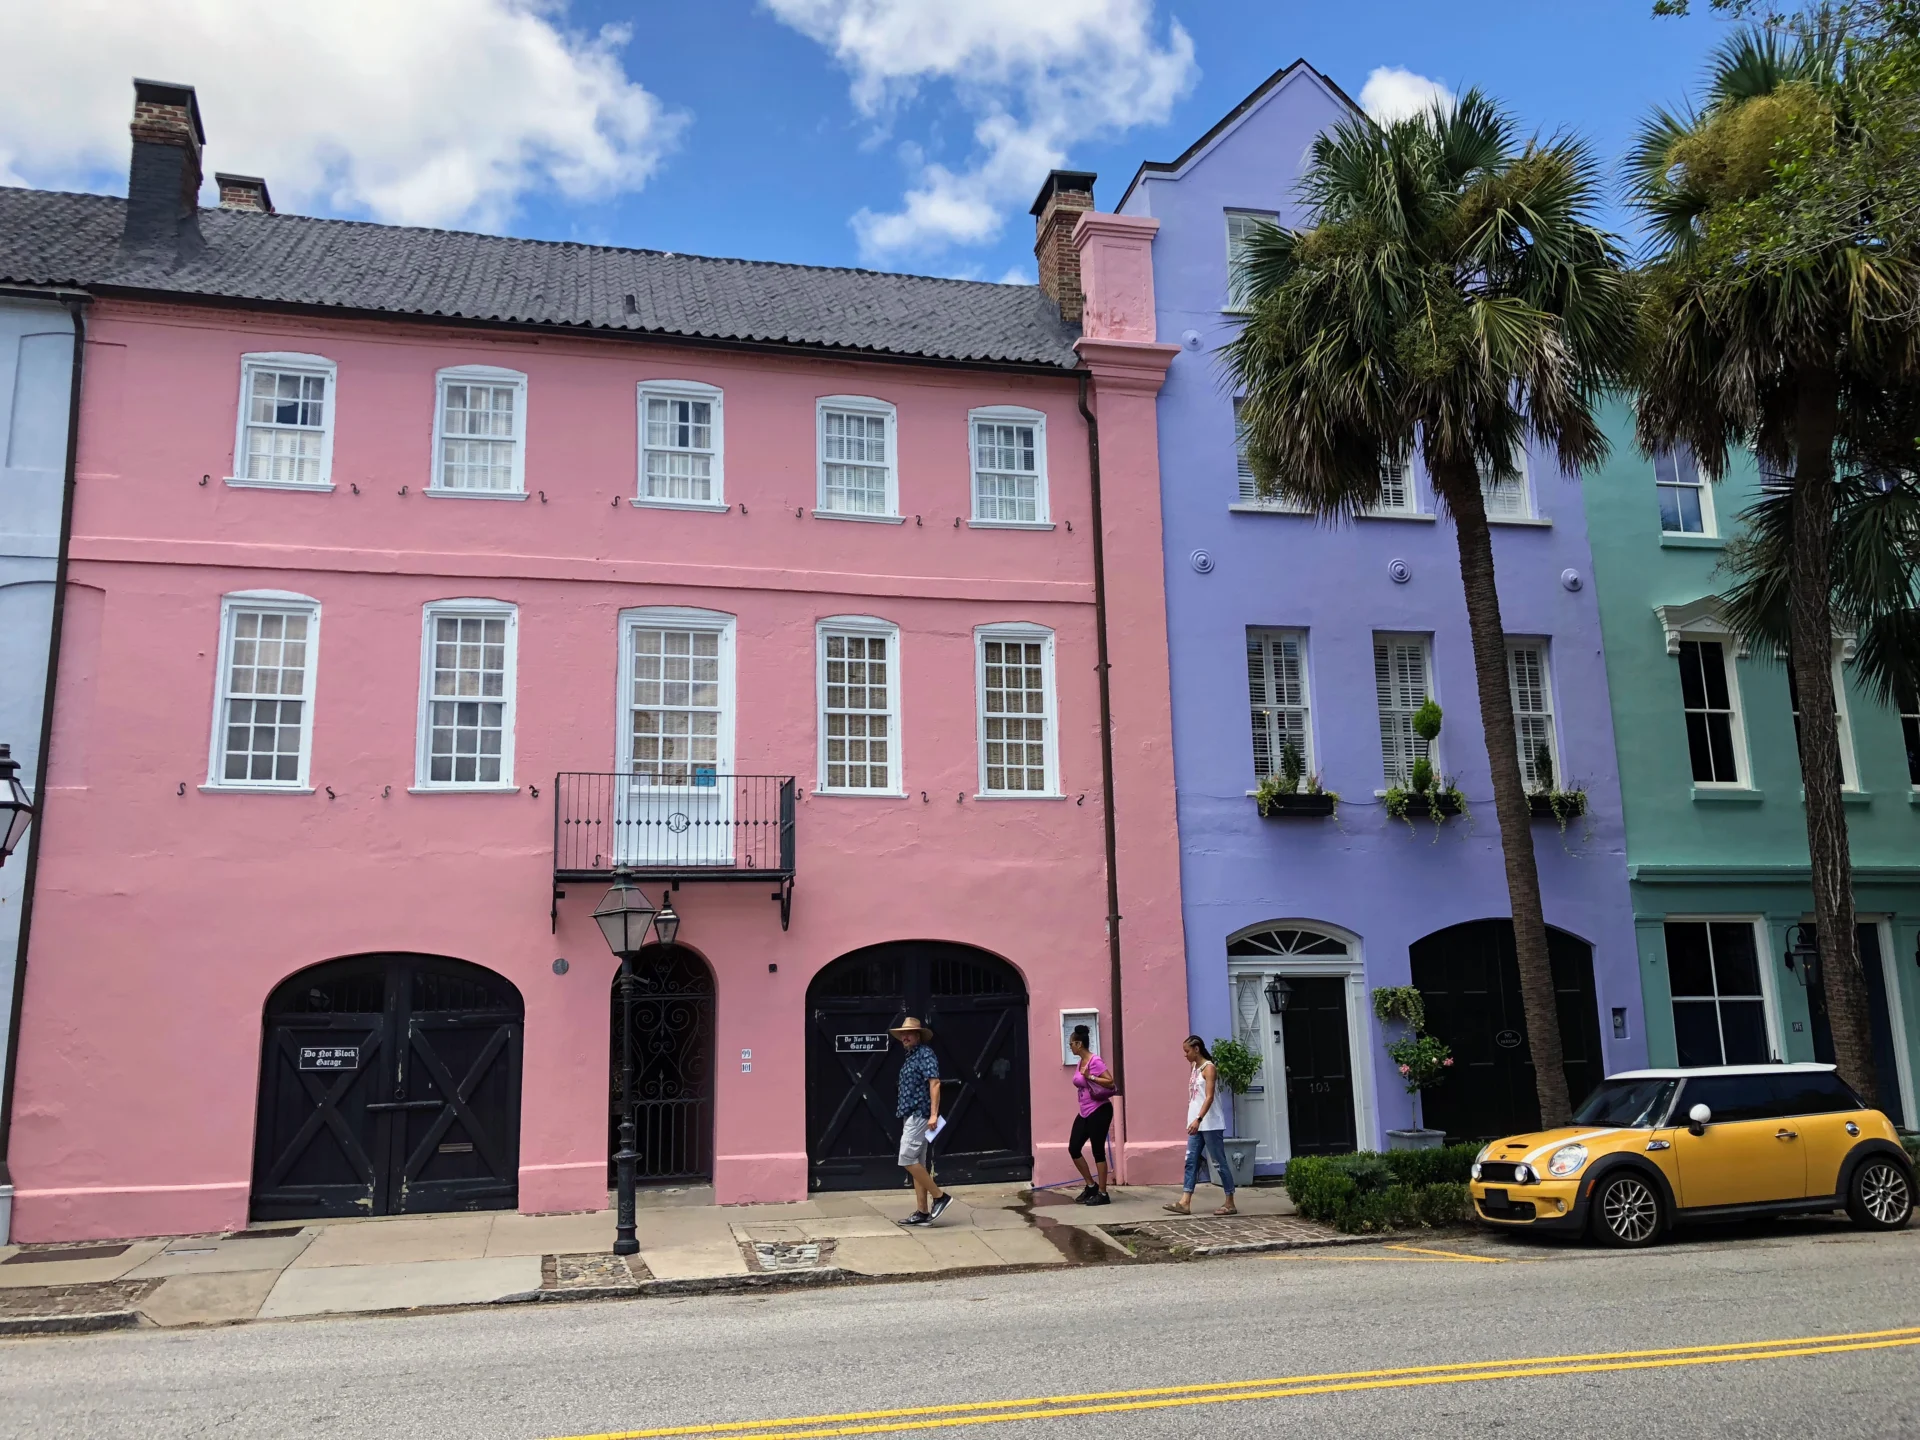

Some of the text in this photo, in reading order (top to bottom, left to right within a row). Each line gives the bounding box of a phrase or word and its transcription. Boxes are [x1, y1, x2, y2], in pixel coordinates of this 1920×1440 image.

[850, 1042, 874, 1051] Garage
[304, 1049, 355, 1058] Do Not Block
[741, 1050, 751, 1058] 99
[316, 1058, 342, 1067] Garage
[742, 1063, 751, 1072] 101
[1309, 1081, 1330, 1093] 103
